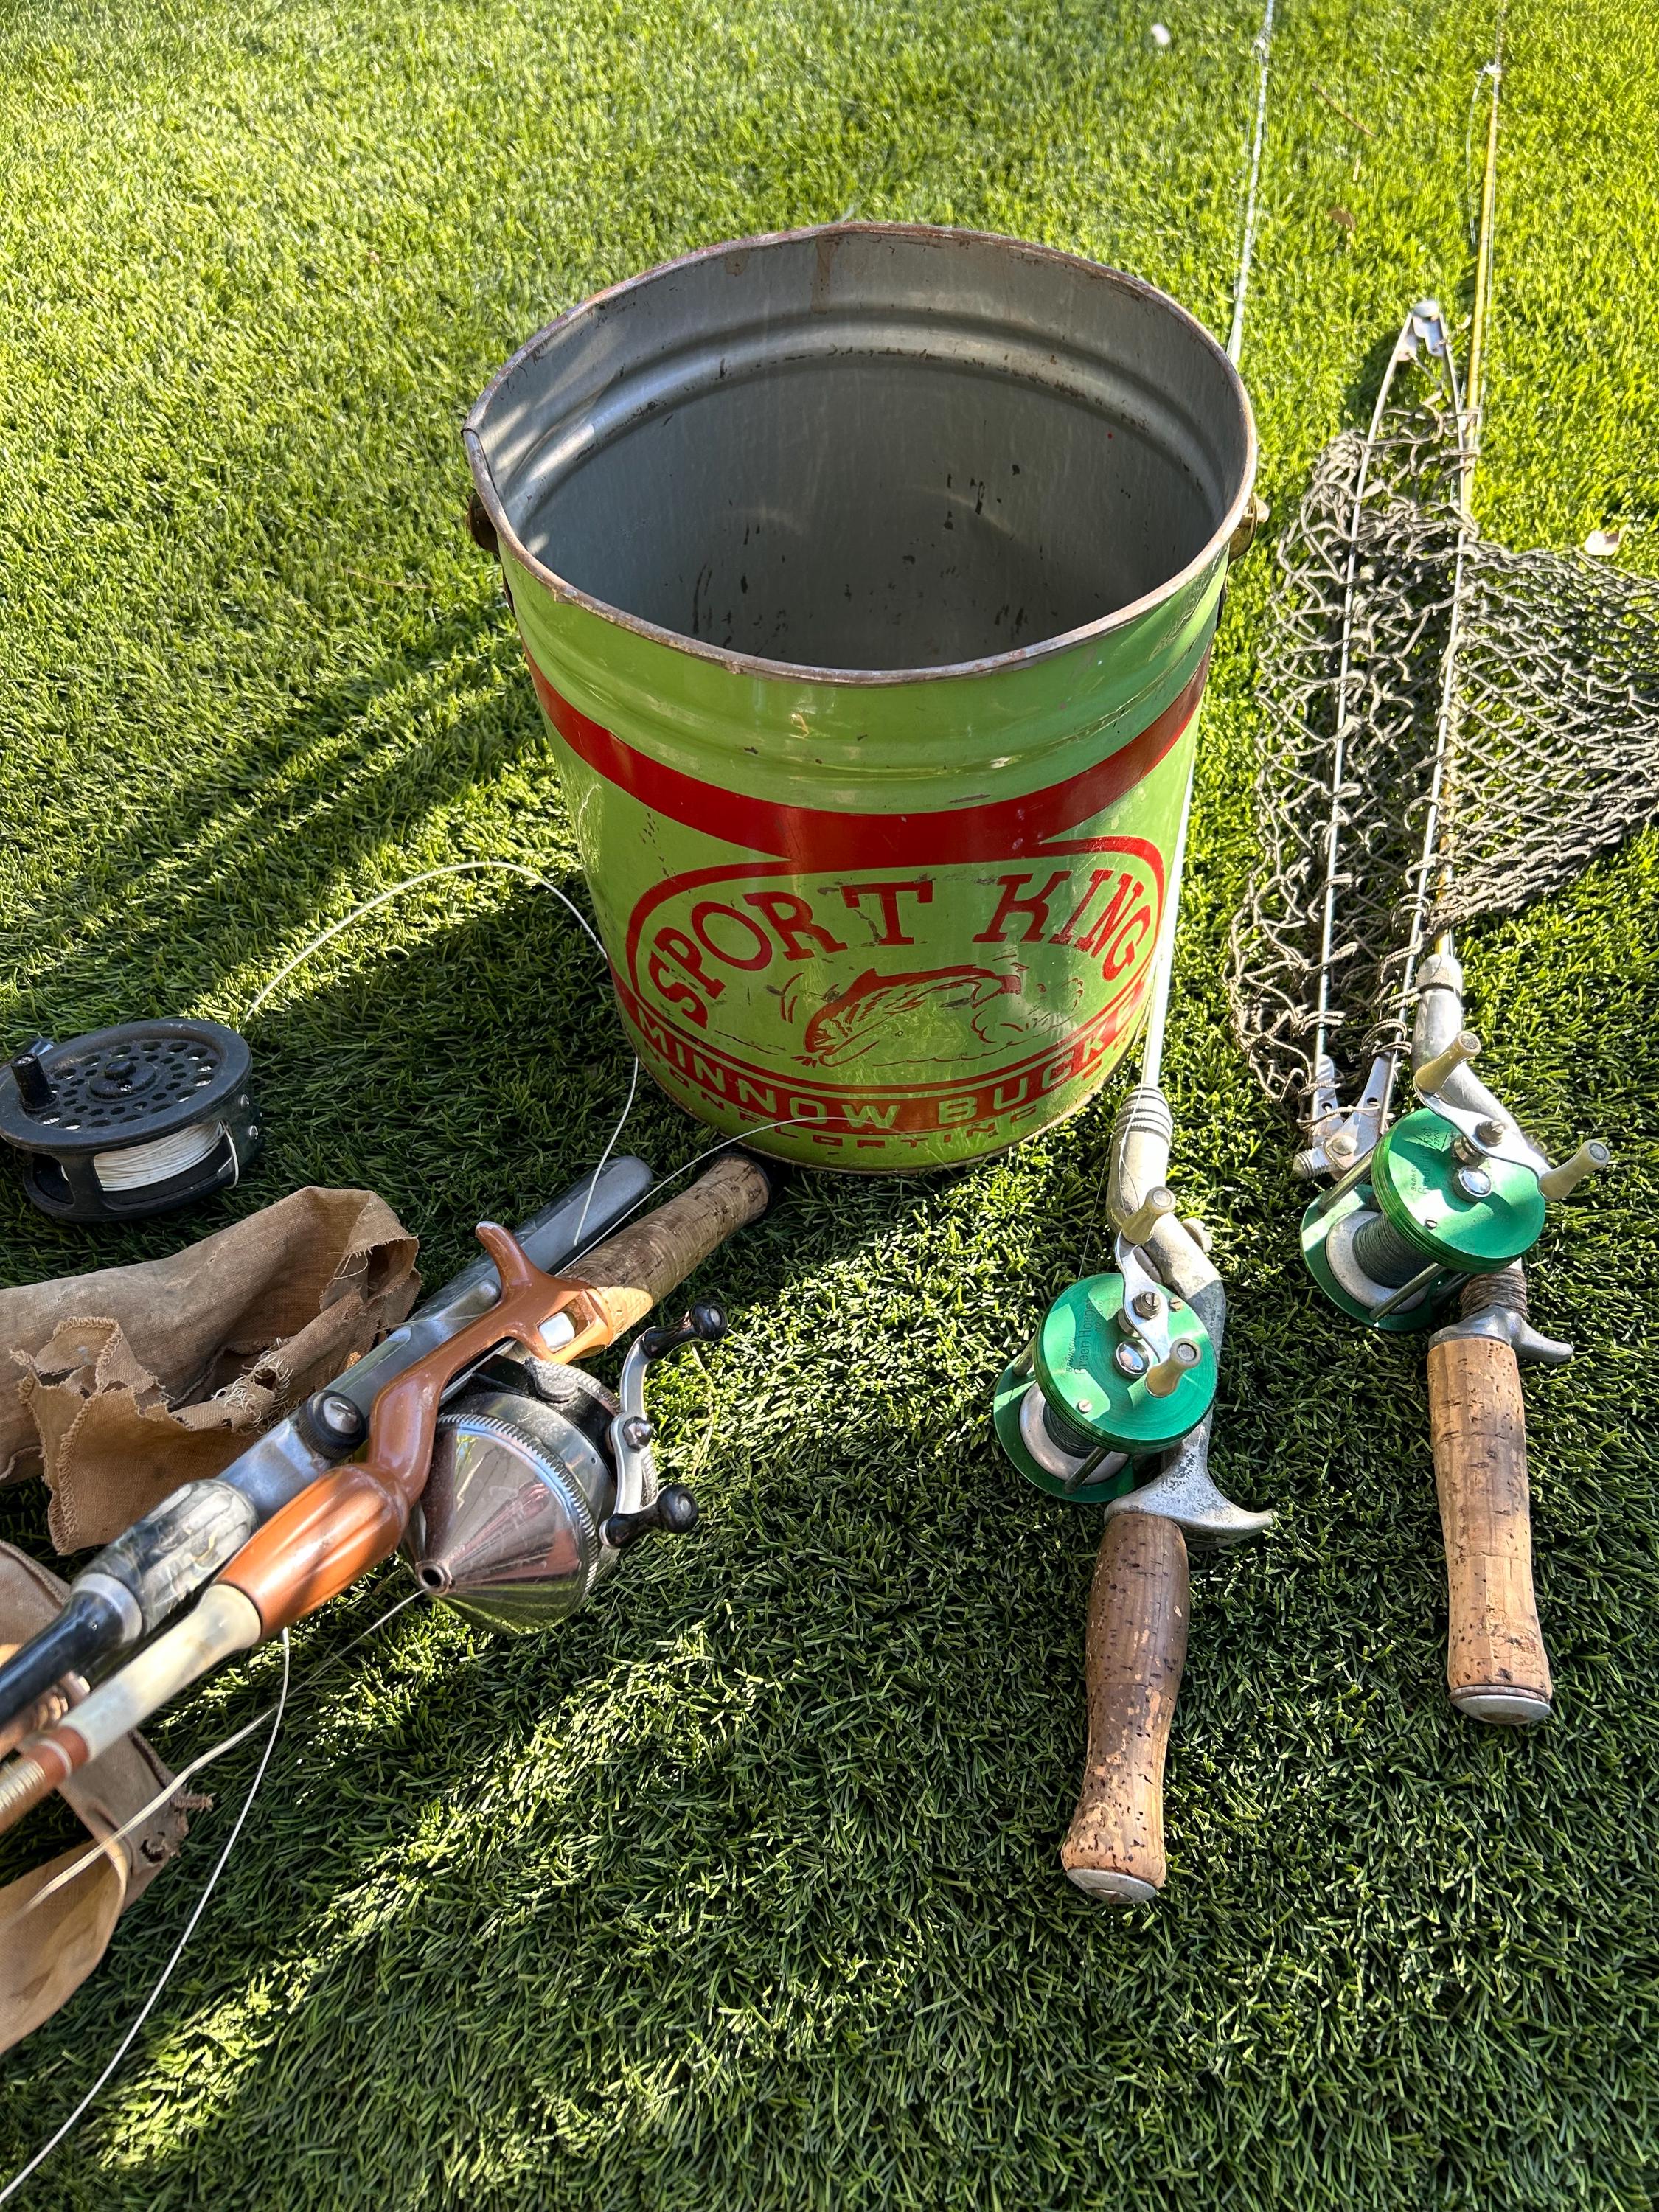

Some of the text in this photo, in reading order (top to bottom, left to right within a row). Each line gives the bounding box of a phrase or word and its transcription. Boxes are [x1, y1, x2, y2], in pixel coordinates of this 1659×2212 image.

[648, 869, 1152, 1030] SPORT KING
[636, 985, 1141, 1129] MINNOW BUCKE
[1065, 1337, 1077, 1373] BRONSON
[1074, 1298, 1096, 1374] Green Hornet
